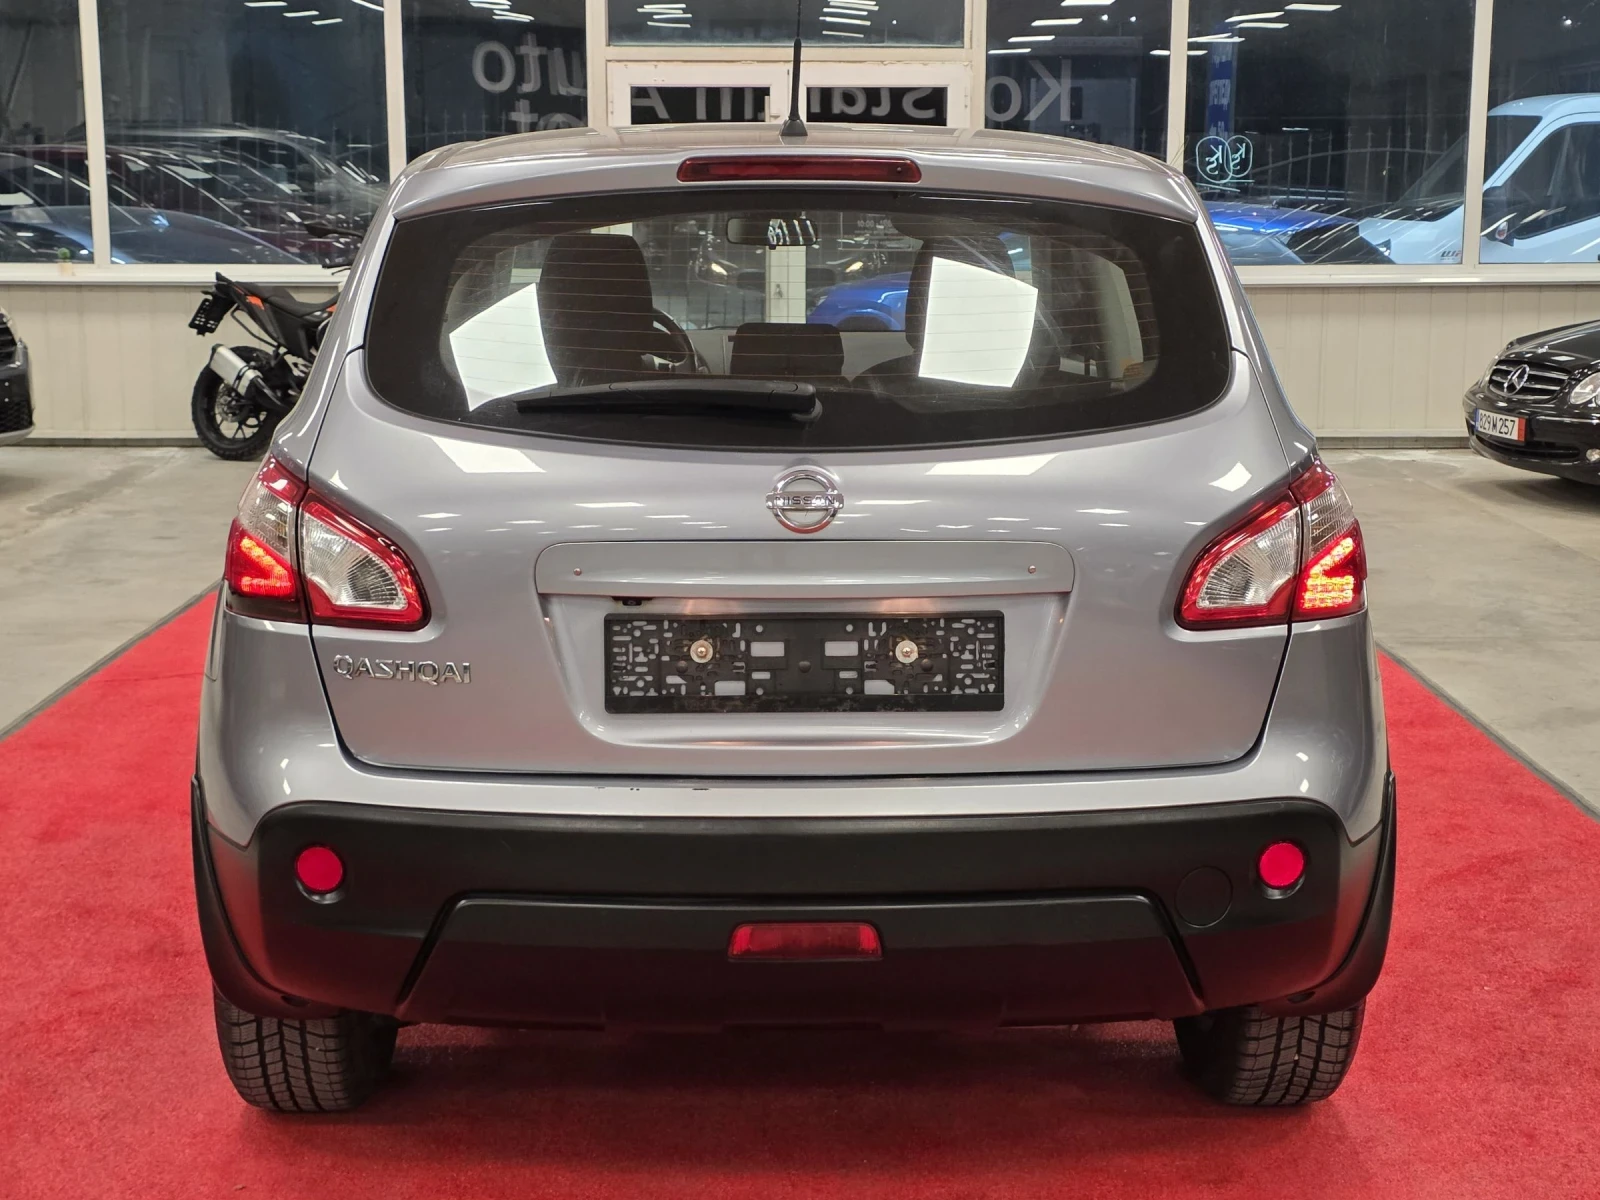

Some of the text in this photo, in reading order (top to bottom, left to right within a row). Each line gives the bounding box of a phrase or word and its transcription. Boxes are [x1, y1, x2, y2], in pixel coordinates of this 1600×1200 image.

[1498, 418, 1516, 436] 257
[775, 495, 835, 506] NISSAN
[333, 654, 472, 686] QASHQAI
